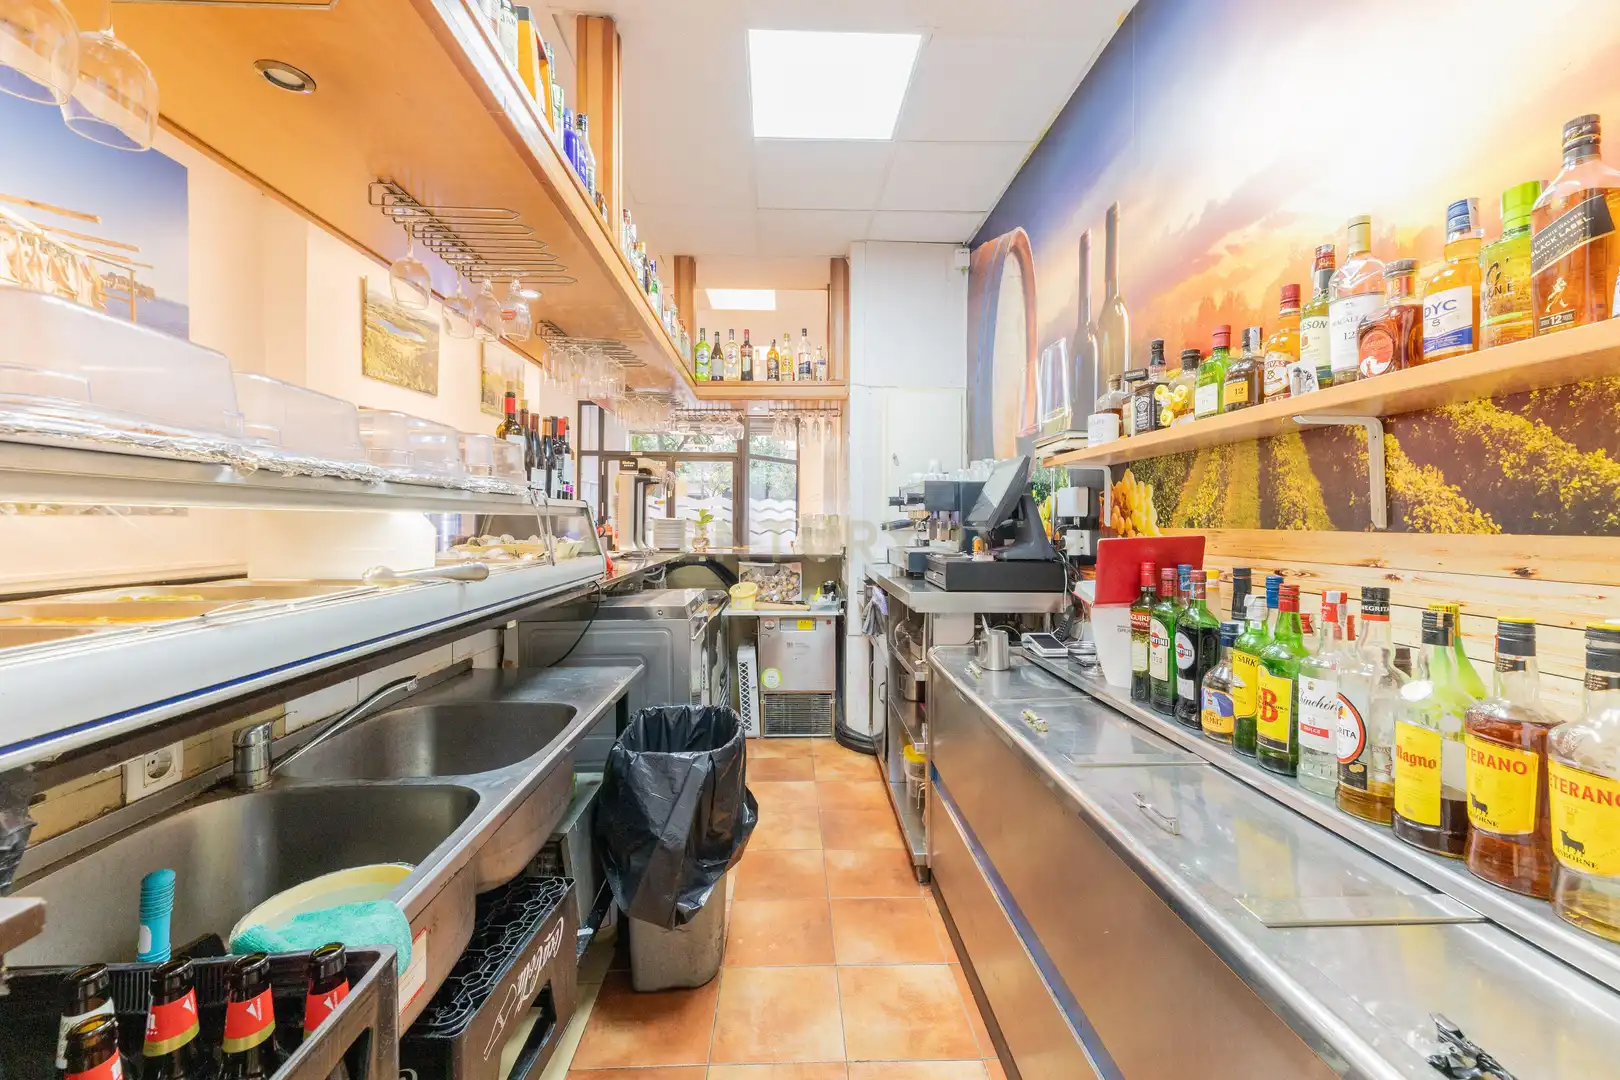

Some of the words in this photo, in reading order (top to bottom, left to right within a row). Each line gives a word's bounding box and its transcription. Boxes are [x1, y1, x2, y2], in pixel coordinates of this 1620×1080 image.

[1424, 299, 1457, 319] DYC
[1550, 315, 1562, 325] 12
[1343, 331, 1355, 341] 12
[1234, 387, 1244, 395] 12
[1237, 655, 1257, 668] SARK
[1395, 744, 1437, 770] Magno
